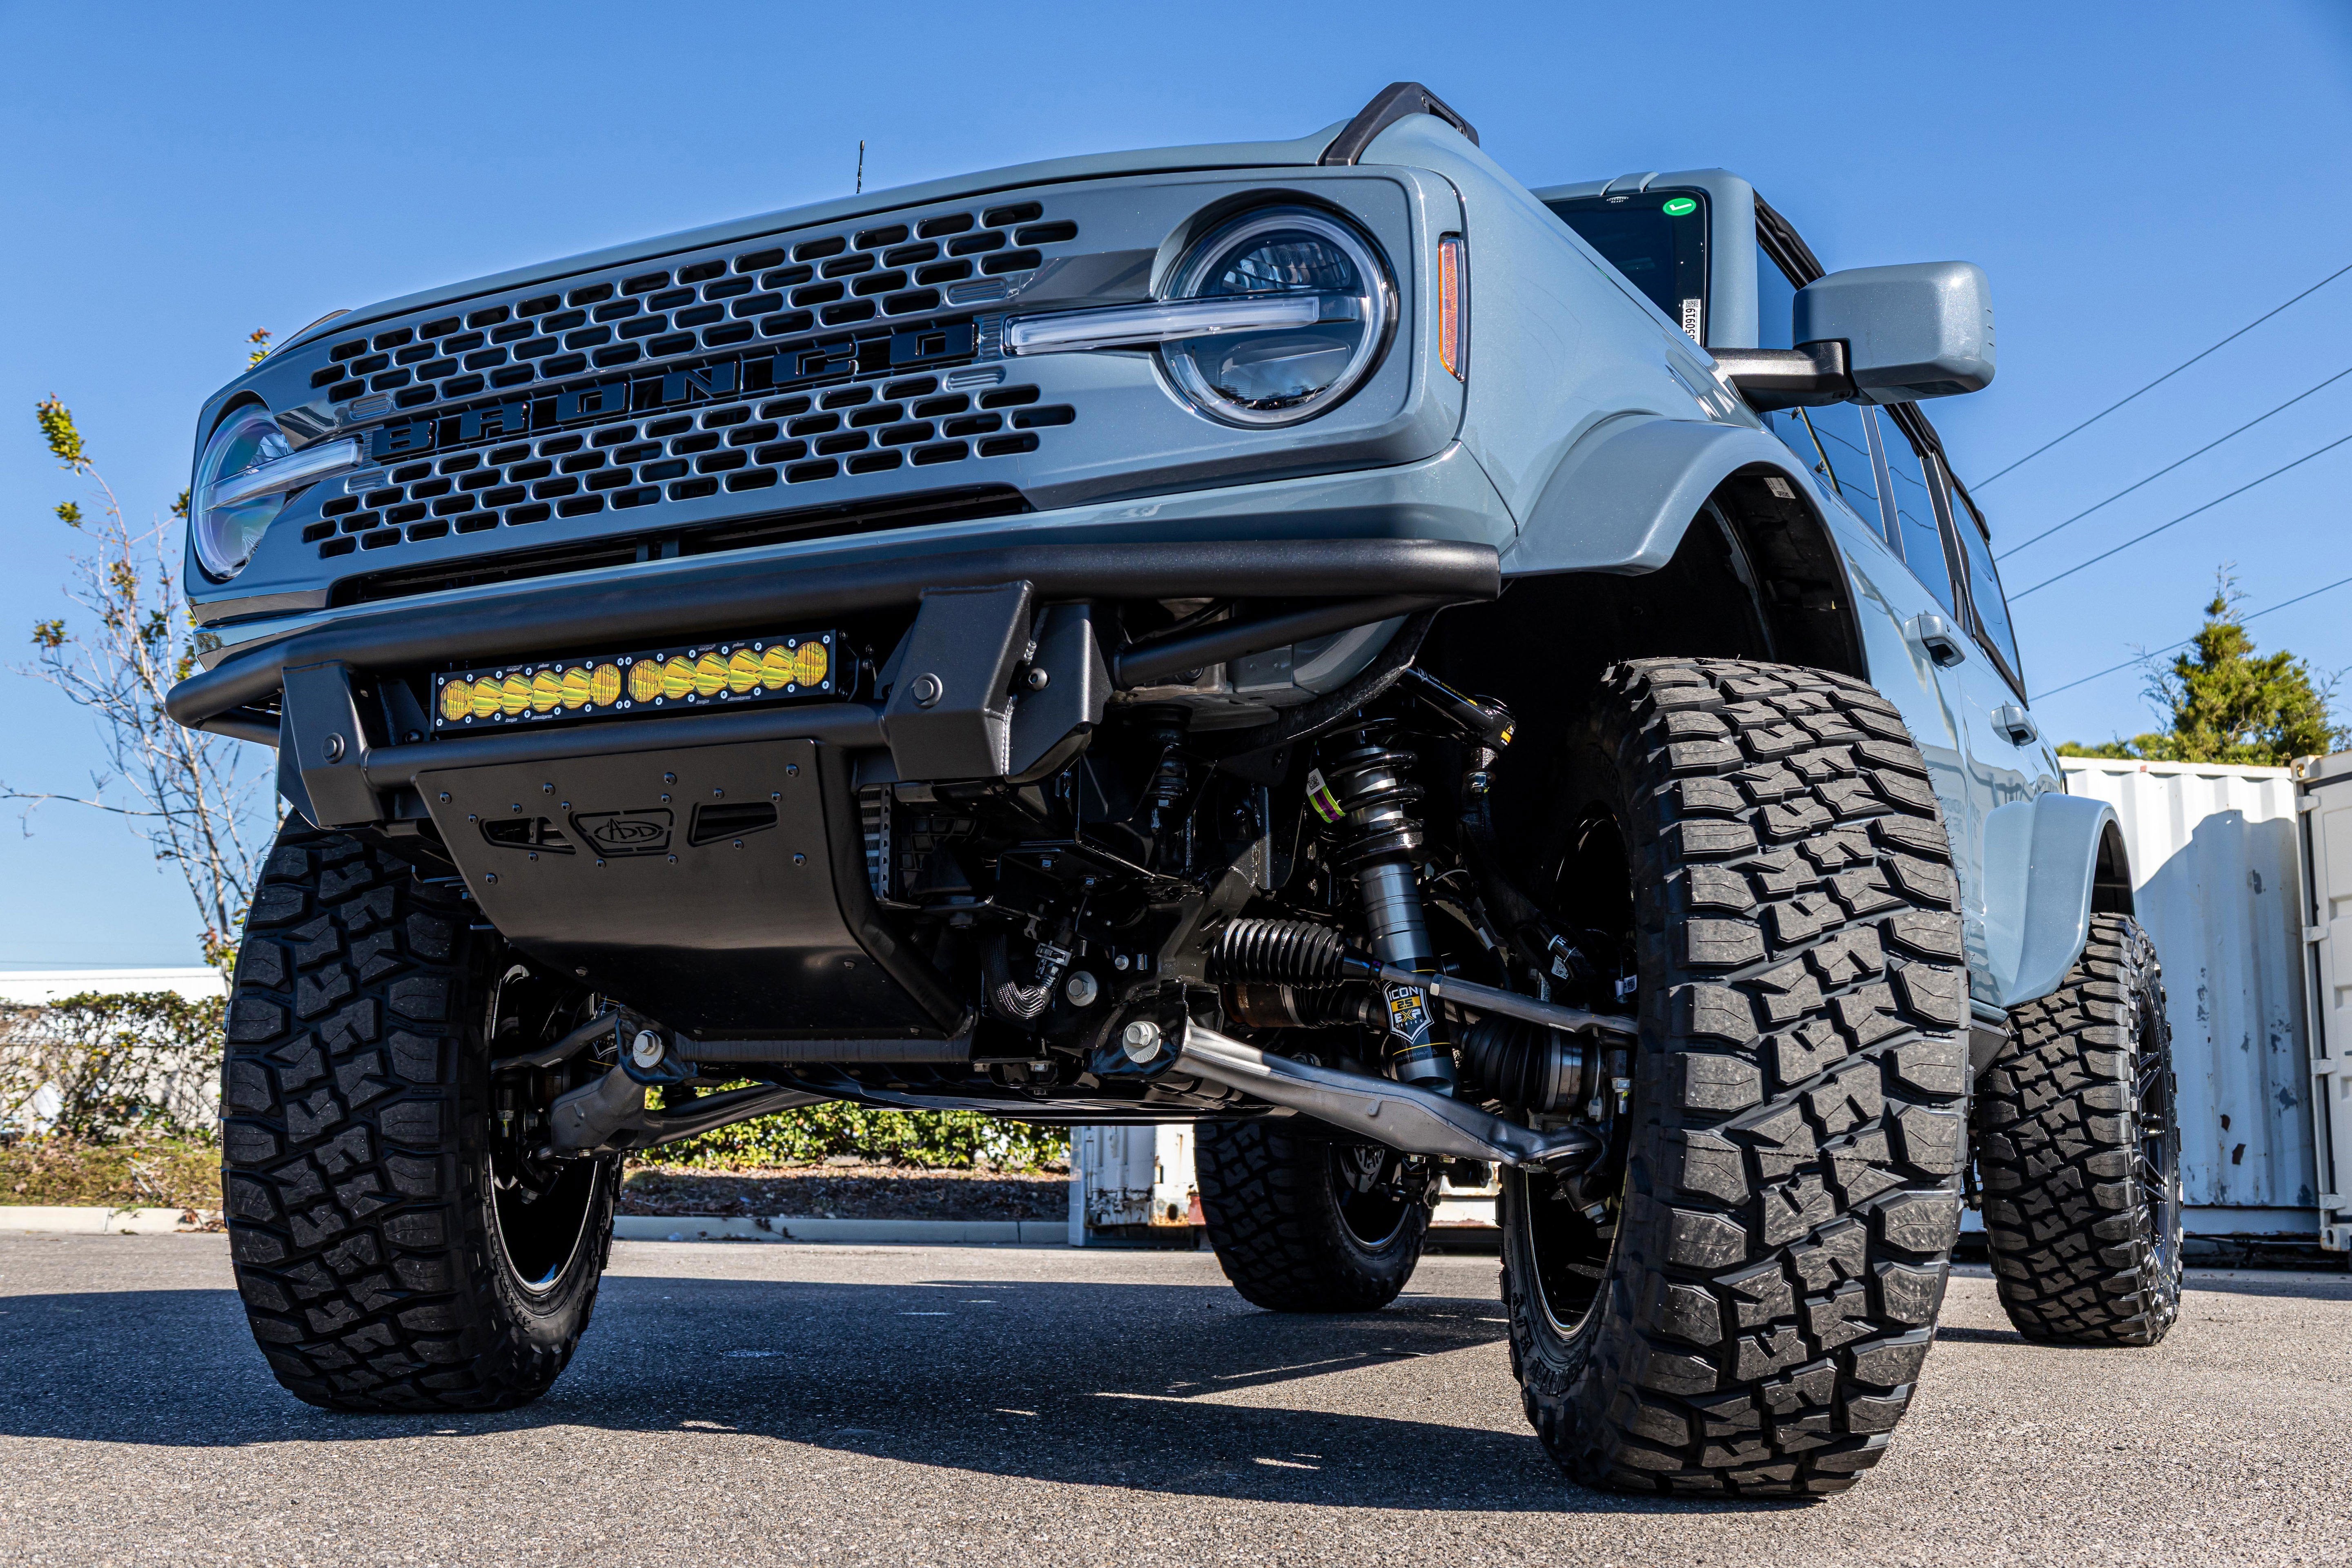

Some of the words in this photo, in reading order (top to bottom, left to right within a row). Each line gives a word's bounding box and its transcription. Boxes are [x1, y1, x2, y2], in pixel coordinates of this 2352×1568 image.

[371, 322, 980, 461] BRONCO
[1388, 986, 1419, 1000] ICON
[1396, 998, 1414, 1010] 2.5
[1394, 1008, 1421, 1023] EXP
[1396, 1019, 1423, 1028] SERIES
